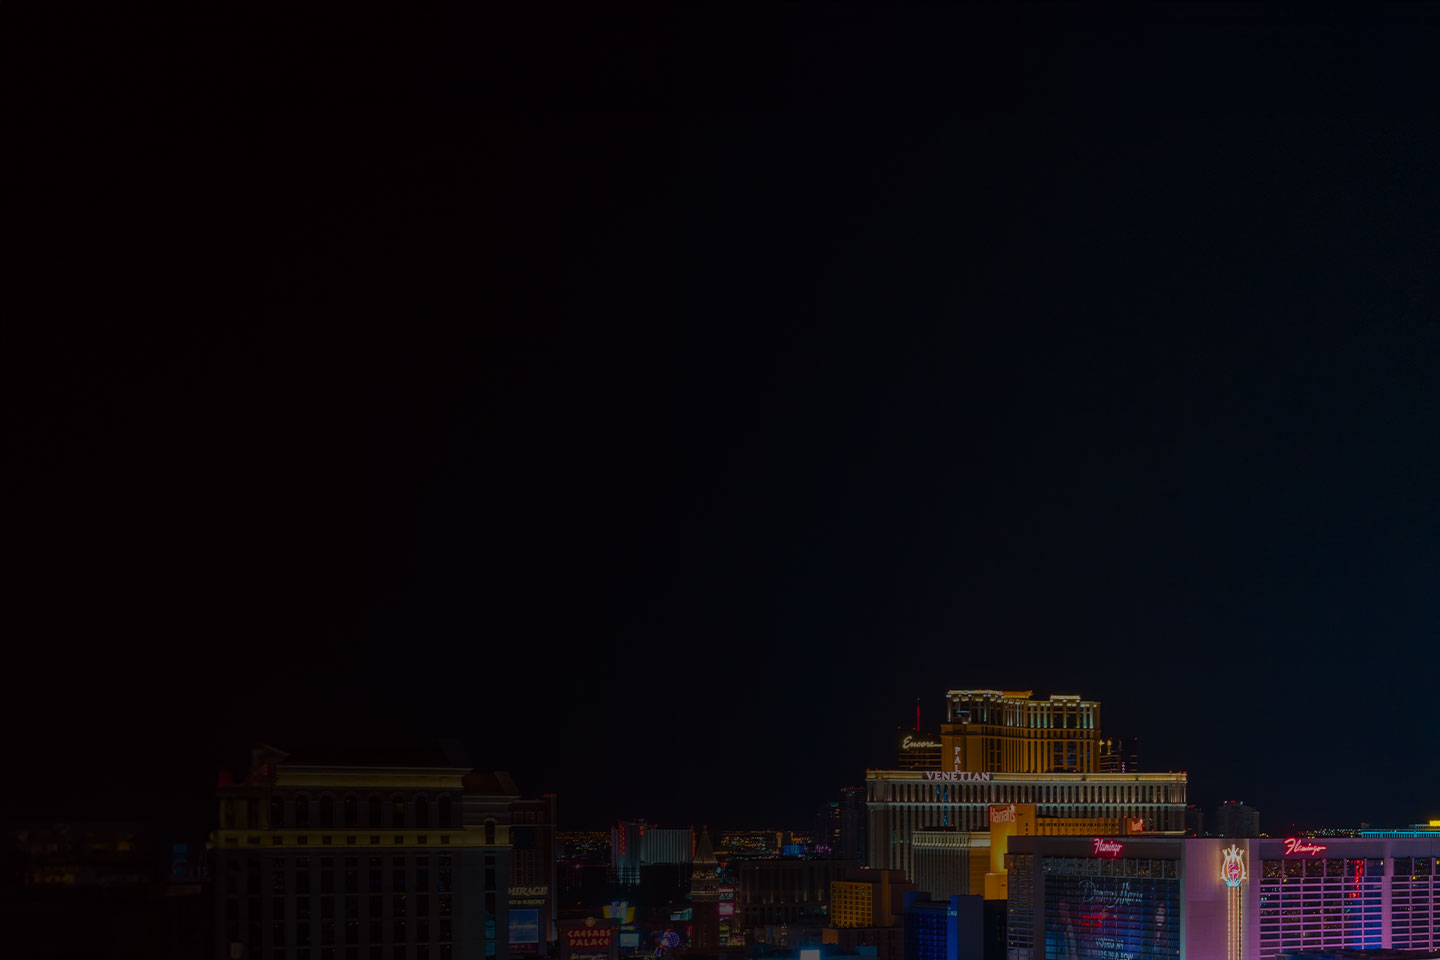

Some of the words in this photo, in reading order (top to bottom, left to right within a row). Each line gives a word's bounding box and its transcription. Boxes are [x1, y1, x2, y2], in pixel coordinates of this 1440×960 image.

[903, 736, 943, 749] Encore
[926, 771, 990, 781] VENETIAN
[1093, 838, 1123, 857] Flamingo
[1284, 838, 1327, 856] Flamingo
[567, 929, 612, 938] CAESARS
[569, 938, 609, 947] PALACE
